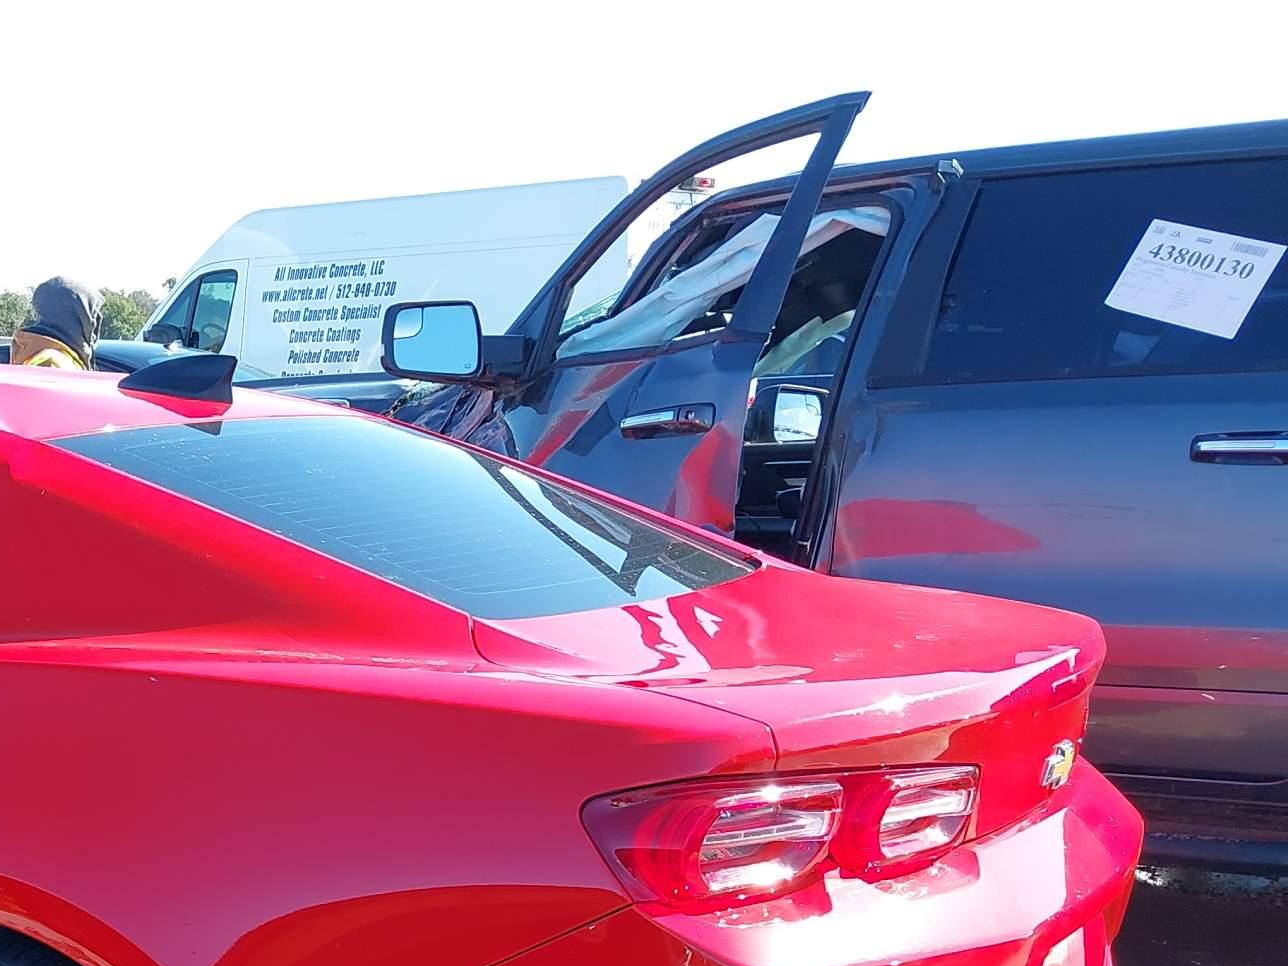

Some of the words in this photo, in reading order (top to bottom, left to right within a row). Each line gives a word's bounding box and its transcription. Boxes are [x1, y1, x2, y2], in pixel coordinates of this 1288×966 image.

[273, 266, 286, 282] All
[286, 264, 328, 281] Innovative
[329, 261, 368, 279] Concrete,
[369, 259, 385, 276] LLC
[1148, 243, 1255, 280] 43800130
[261, 284, 329, 303] www.allcrete.net
[272, 308, 301, 323] Custom
[302, 305, 339, 322] Concrete
[340, 303, 382, 322] Specialist
[288, 328, 325, 344] Concrete
[325, 326, 361, 344] Coatings
[287, 349, 322, 364] Polished
[322, 347, 360, 363] Concrete
